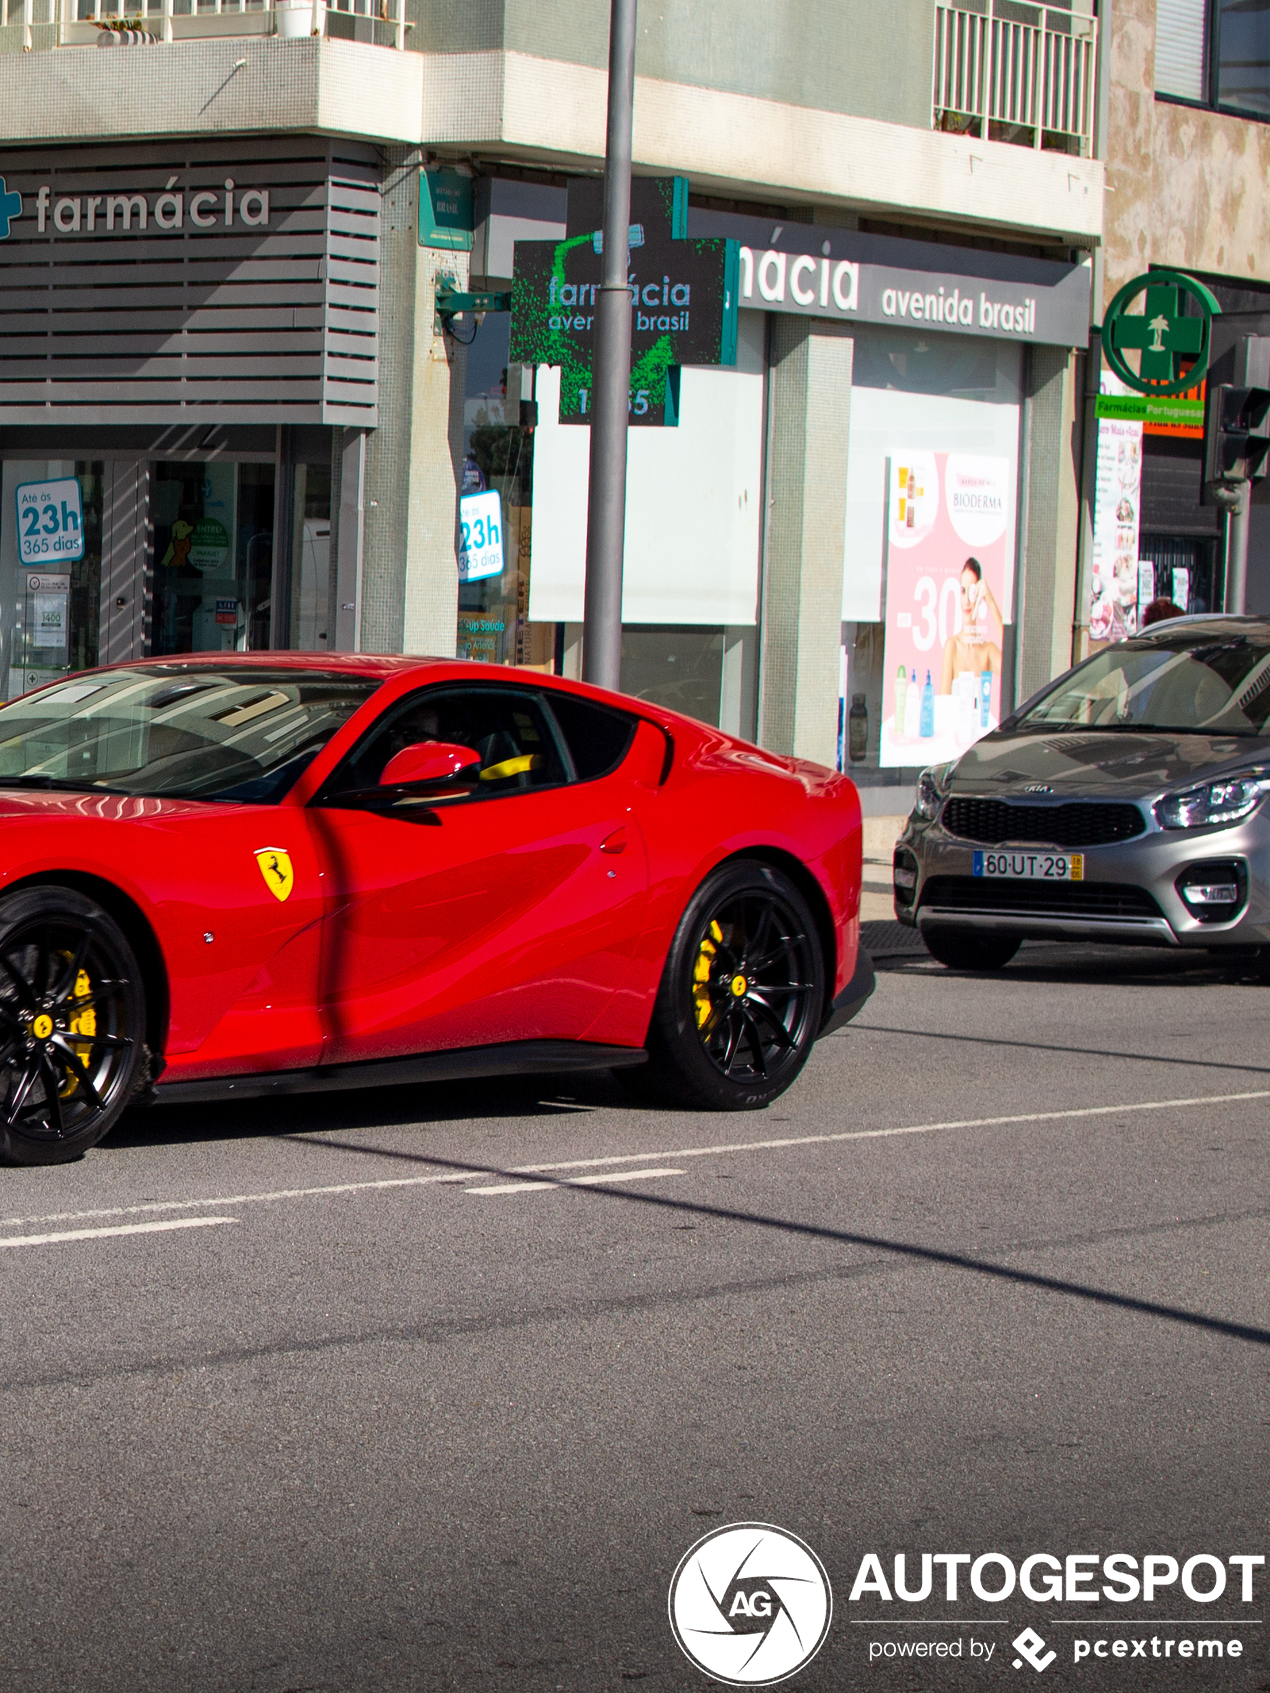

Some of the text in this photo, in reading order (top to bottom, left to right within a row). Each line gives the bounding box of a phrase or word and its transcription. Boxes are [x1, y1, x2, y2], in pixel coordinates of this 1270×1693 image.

[36, 175, 270, 233] farmácia
[882, 286, 973, 327] avenida
[980, 291, 1036, 334] brasil
[637, 311, 690, 331] brasil
[22, 492, 51, 504] Até às
[953, 493, 1002, 509] BIODERMA
[22, 500, 79, 537] 23h
[460, 514, 500, 553] 23h
[23, 535, 80, 555] 365 dias
[481, 550, 500, 566] dias
[480, 619, 505, 632] Saúde
[524, 619, 533, 664] NATURA
